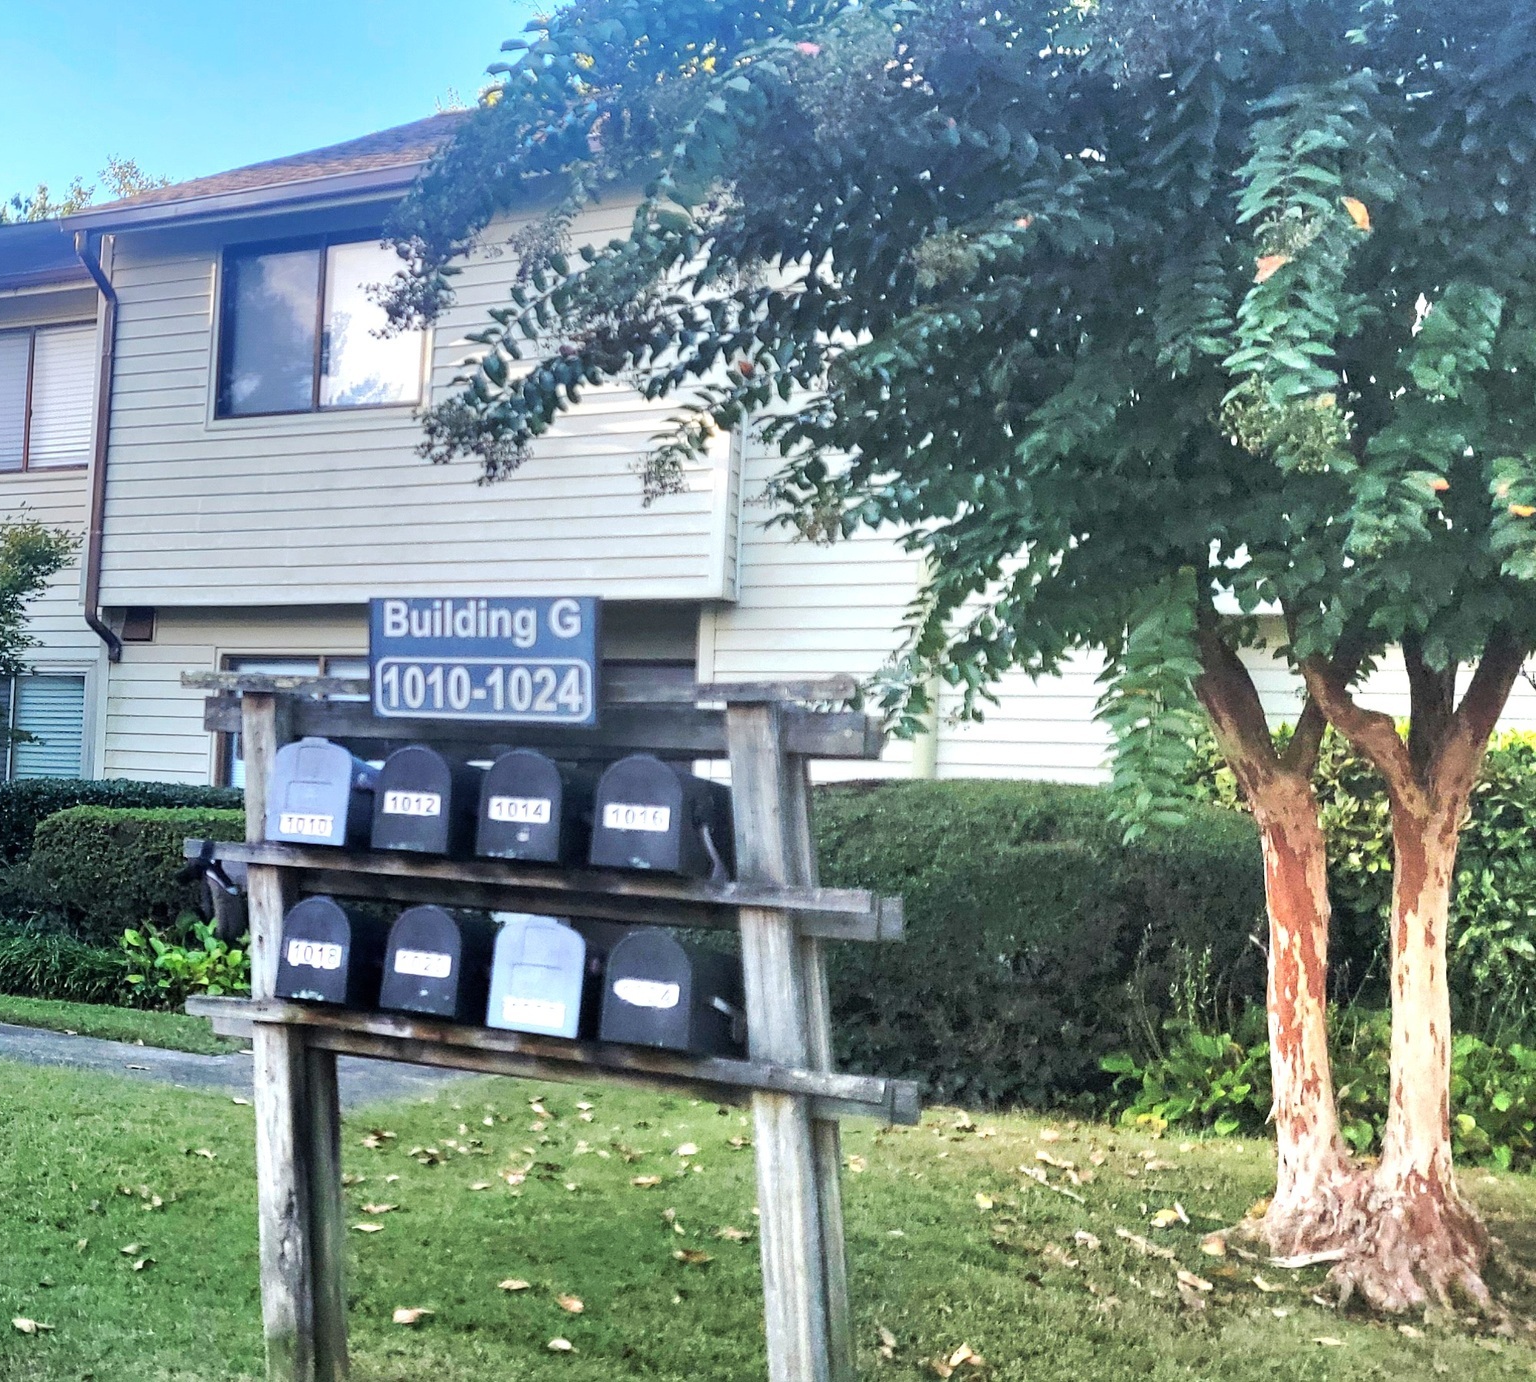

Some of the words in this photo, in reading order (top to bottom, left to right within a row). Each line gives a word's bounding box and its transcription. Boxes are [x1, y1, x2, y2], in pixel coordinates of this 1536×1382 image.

[383, 599, 537, 648] Building
[548, 598, 582, 639] G
[382, 665, 584, 712] 1010-1024
[391, 796, 435, 812] 1012
[495, 802, 542, 818] 1014
[287, 816, 327, 834] 1010
[612, 808, 662, 826] 1016
[294, 944, 337, 964] 1018
